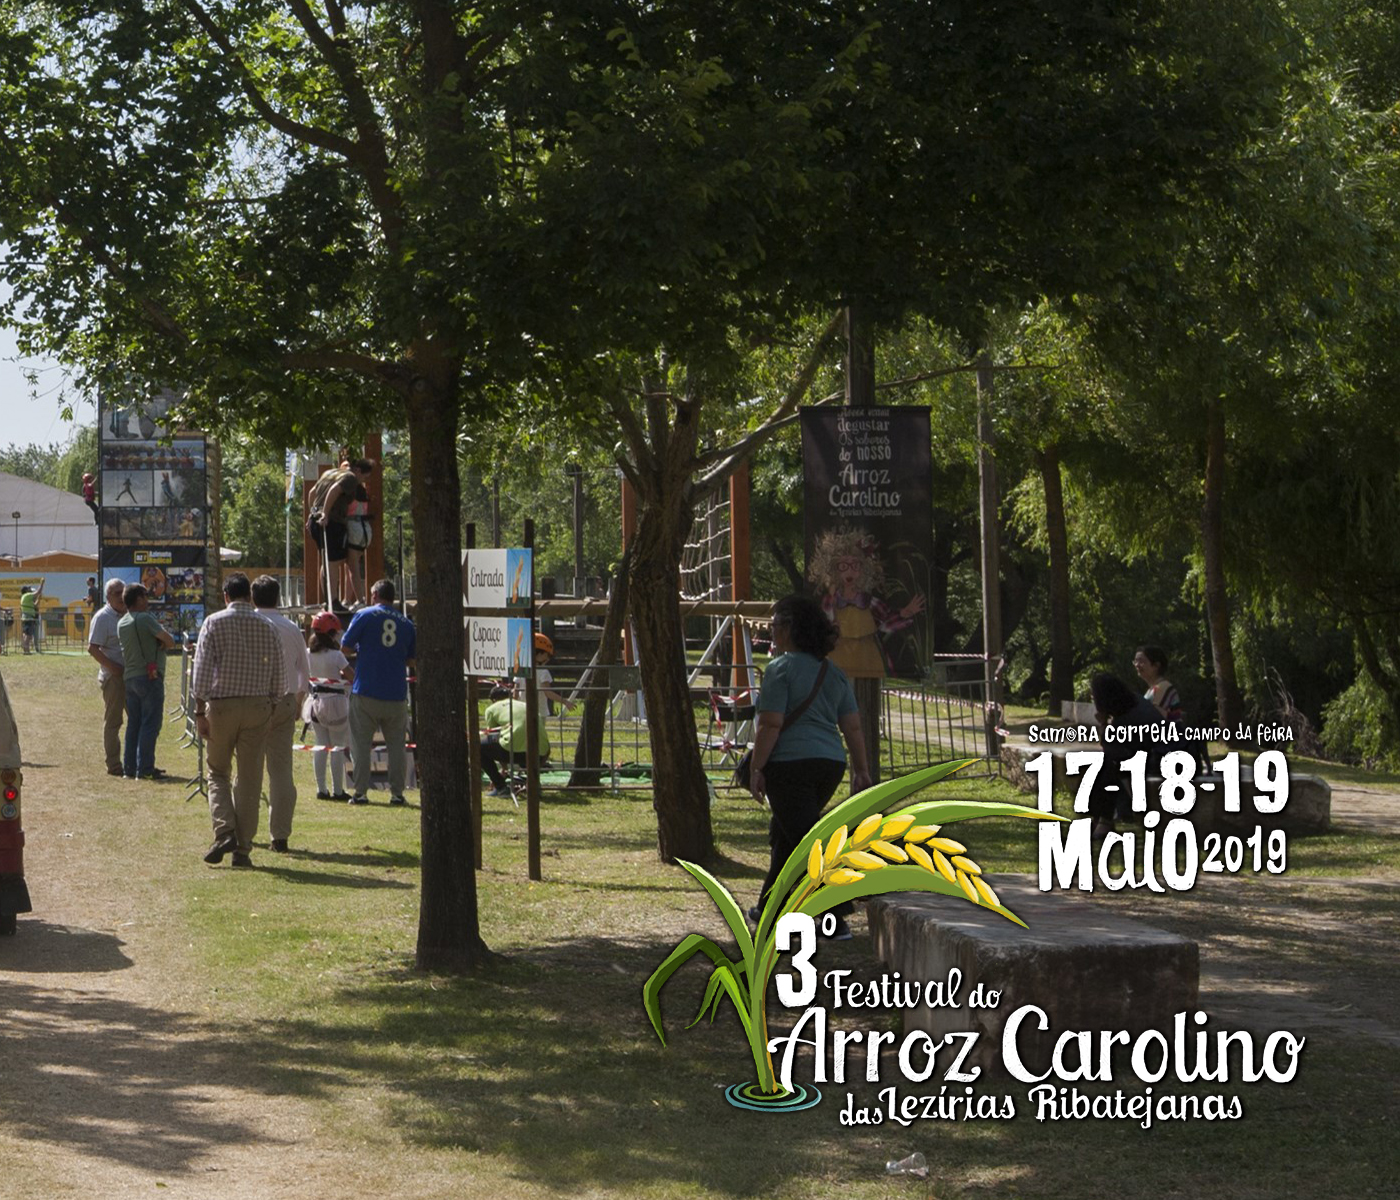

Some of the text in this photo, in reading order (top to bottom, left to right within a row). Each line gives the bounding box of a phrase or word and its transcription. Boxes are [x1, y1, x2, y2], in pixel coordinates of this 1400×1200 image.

[837, 416, 890, 434] degustar
[837, 432, 853, 446] Os
[838, 446, 852, 462] do
[837, 463, 891, 487] Arroz
[828, 485, 902, 507] Carolino
[470, 566, 505, 588] Entrada
[381, 618, 397, 648] 8
[472, 620, 502, 648] Espaço
[473, 648, 506, 675] Criança
